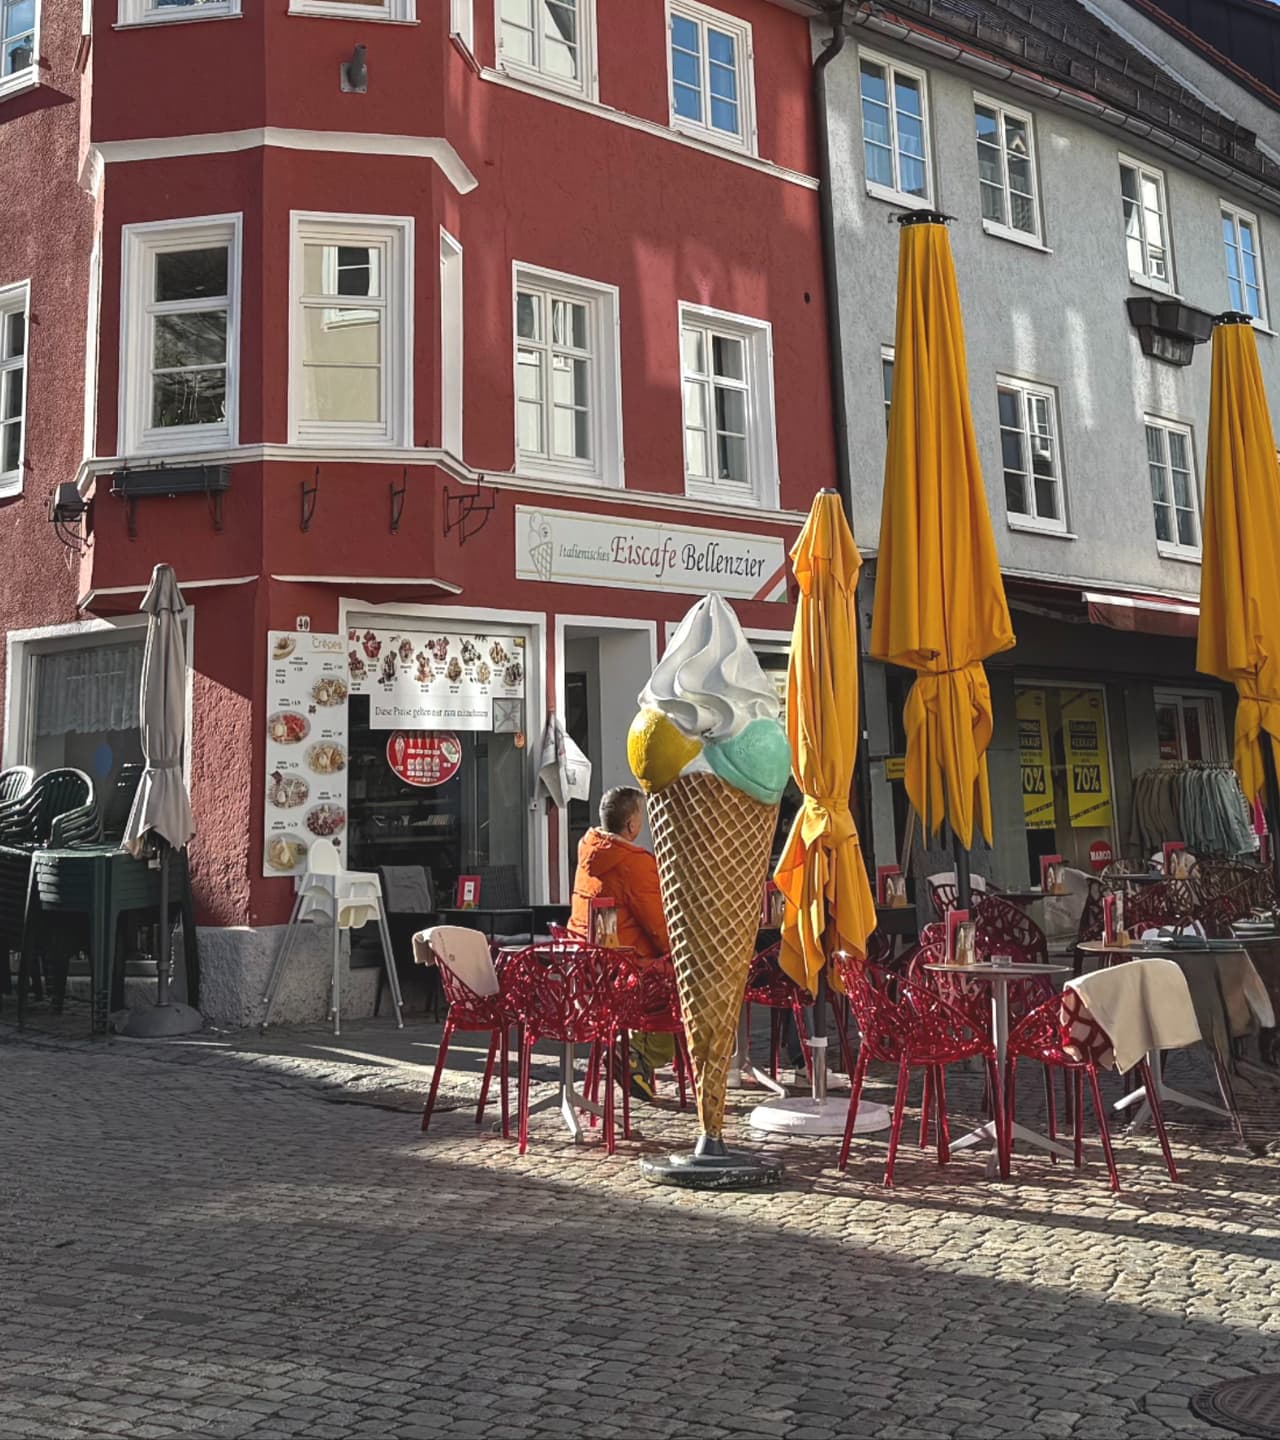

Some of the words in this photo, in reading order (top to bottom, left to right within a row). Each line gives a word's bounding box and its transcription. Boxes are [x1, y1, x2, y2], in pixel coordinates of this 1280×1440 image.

[559, 544, 610, 561] Italienisches
[610, 536, 677, 578] Eiscafe
[681, 542, 766, 578] Bellenzier
[298, 618, 309, 630] 40
[1021, 767, 1044, 792] 0%
[1074, 767, 1100, 791] 70%
